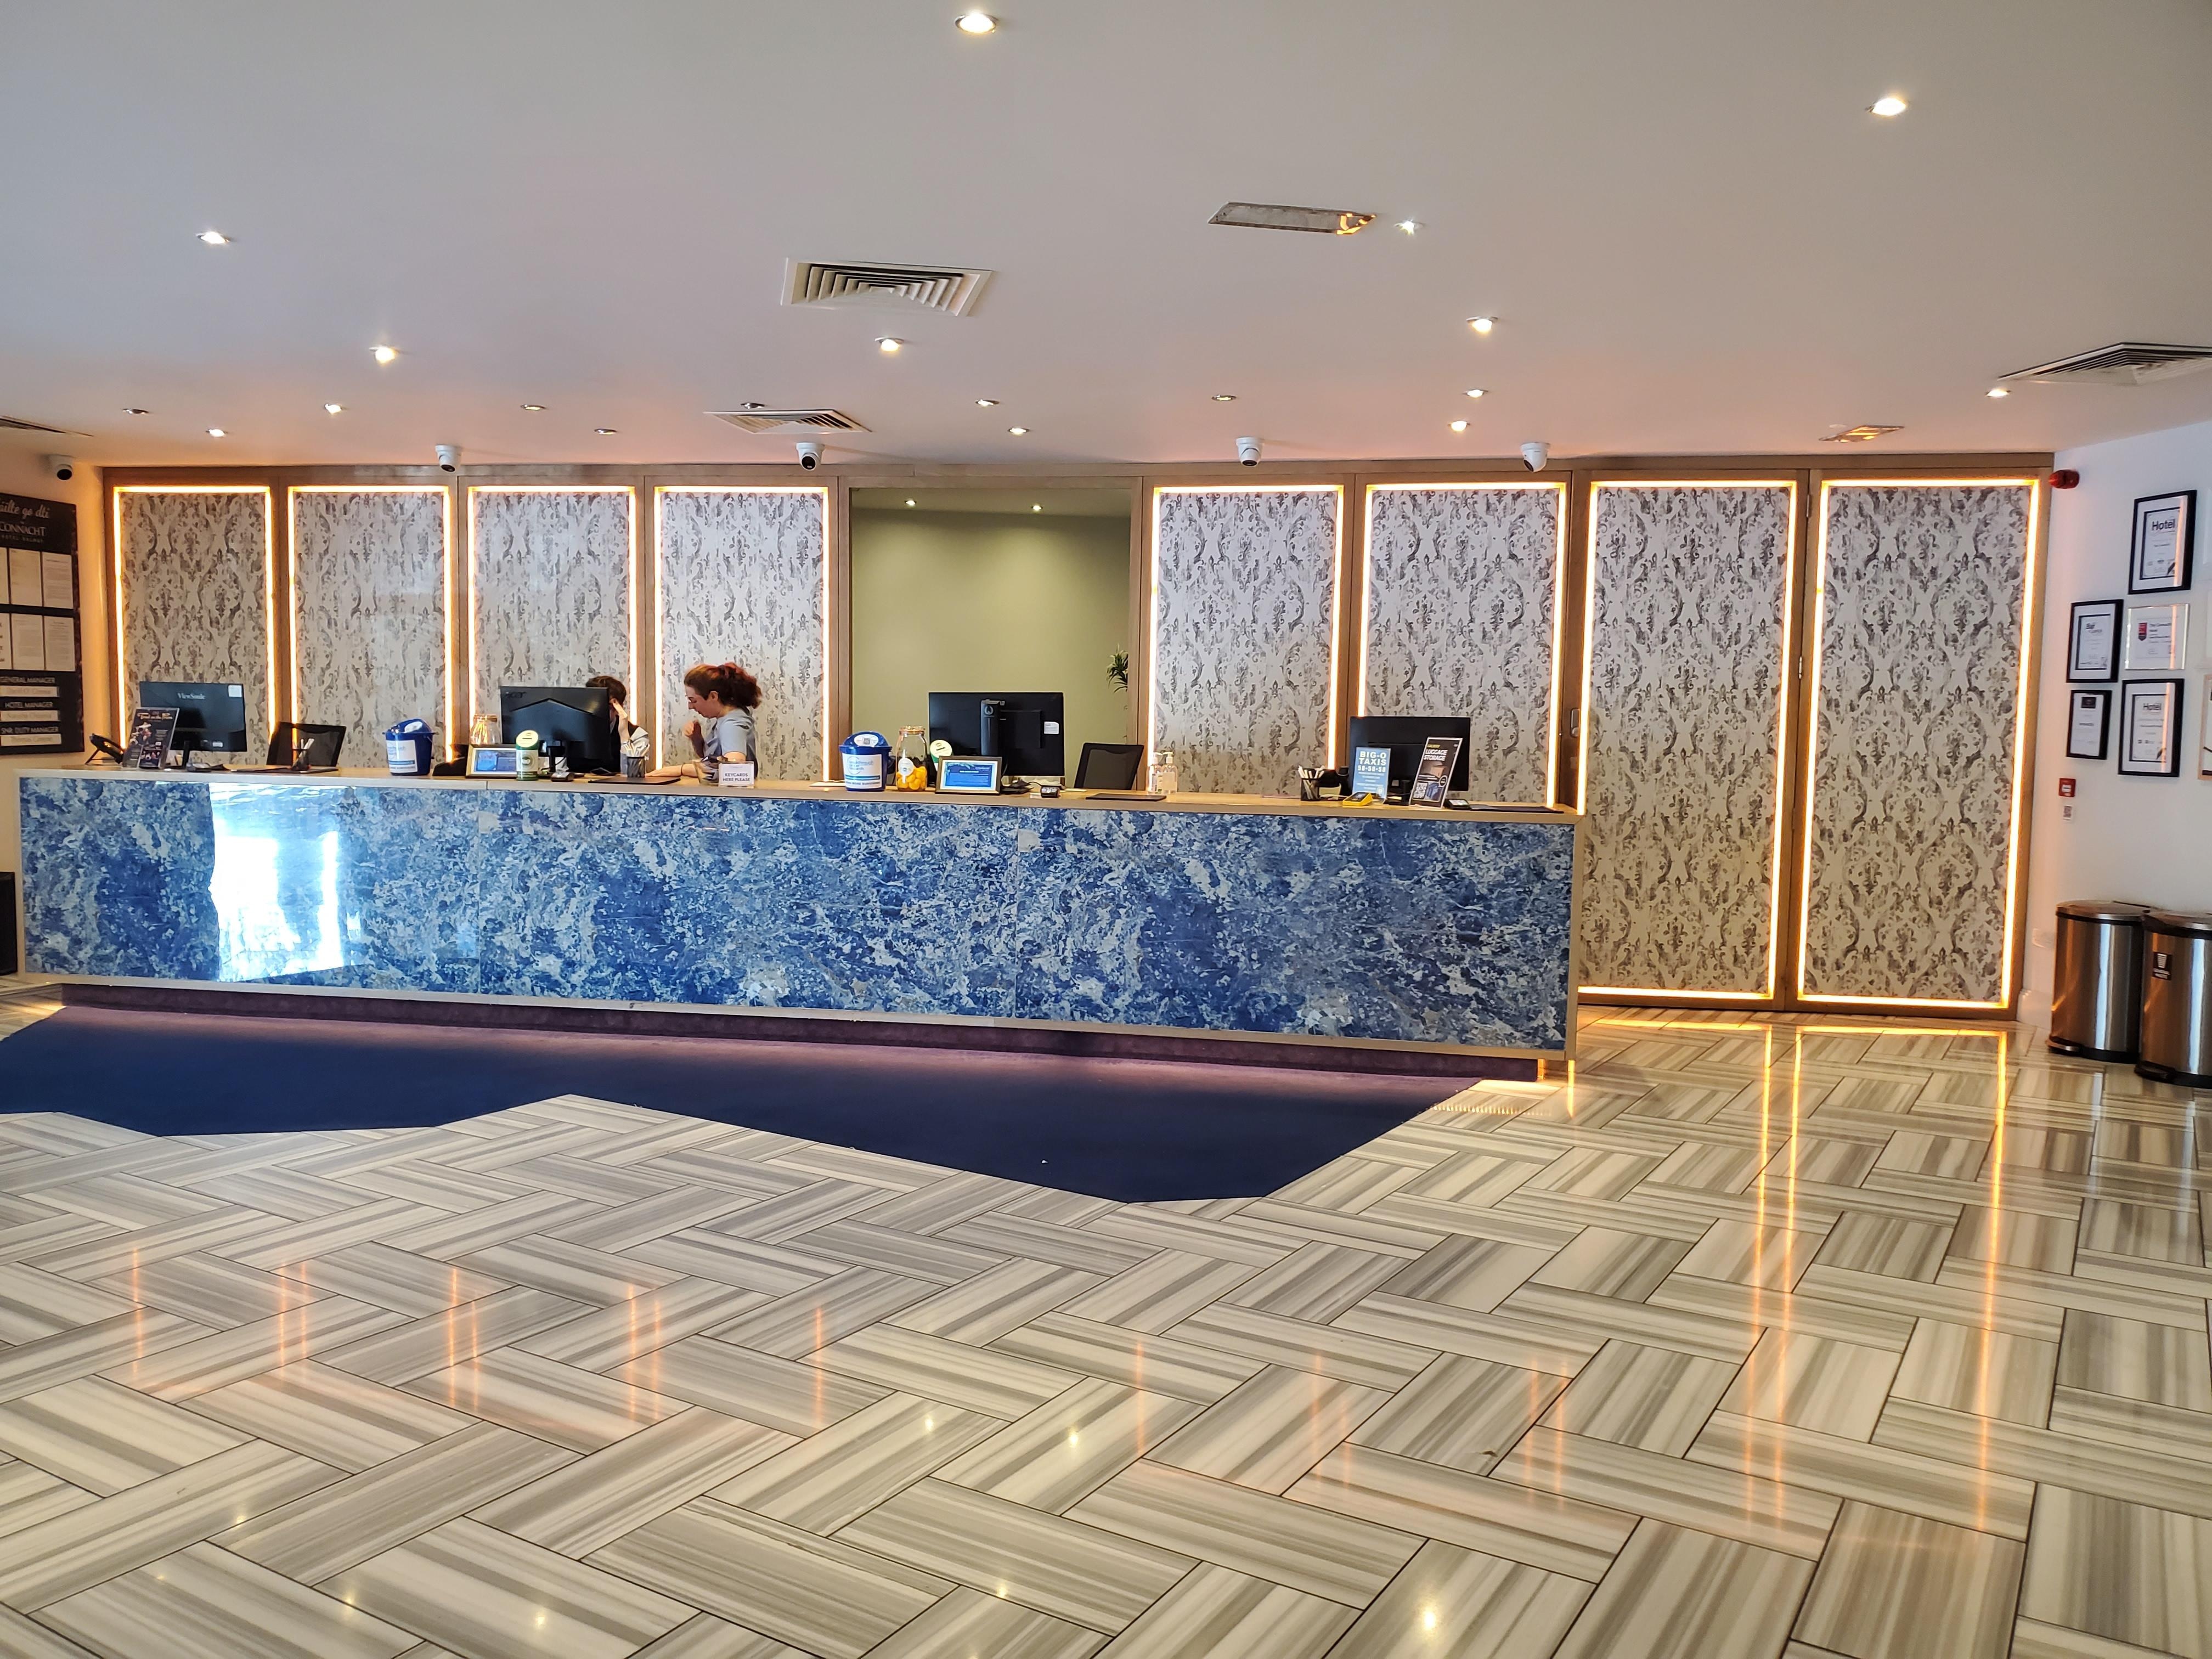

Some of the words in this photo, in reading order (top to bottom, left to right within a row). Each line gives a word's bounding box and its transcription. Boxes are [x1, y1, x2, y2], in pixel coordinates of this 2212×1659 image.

[22, 508, 33, 519] go
[0, 521, 47, 536] CONNACHT
[2152, 518, 2175, 531] Hotel
[1359, 758, 1386, 766] TAXIS
